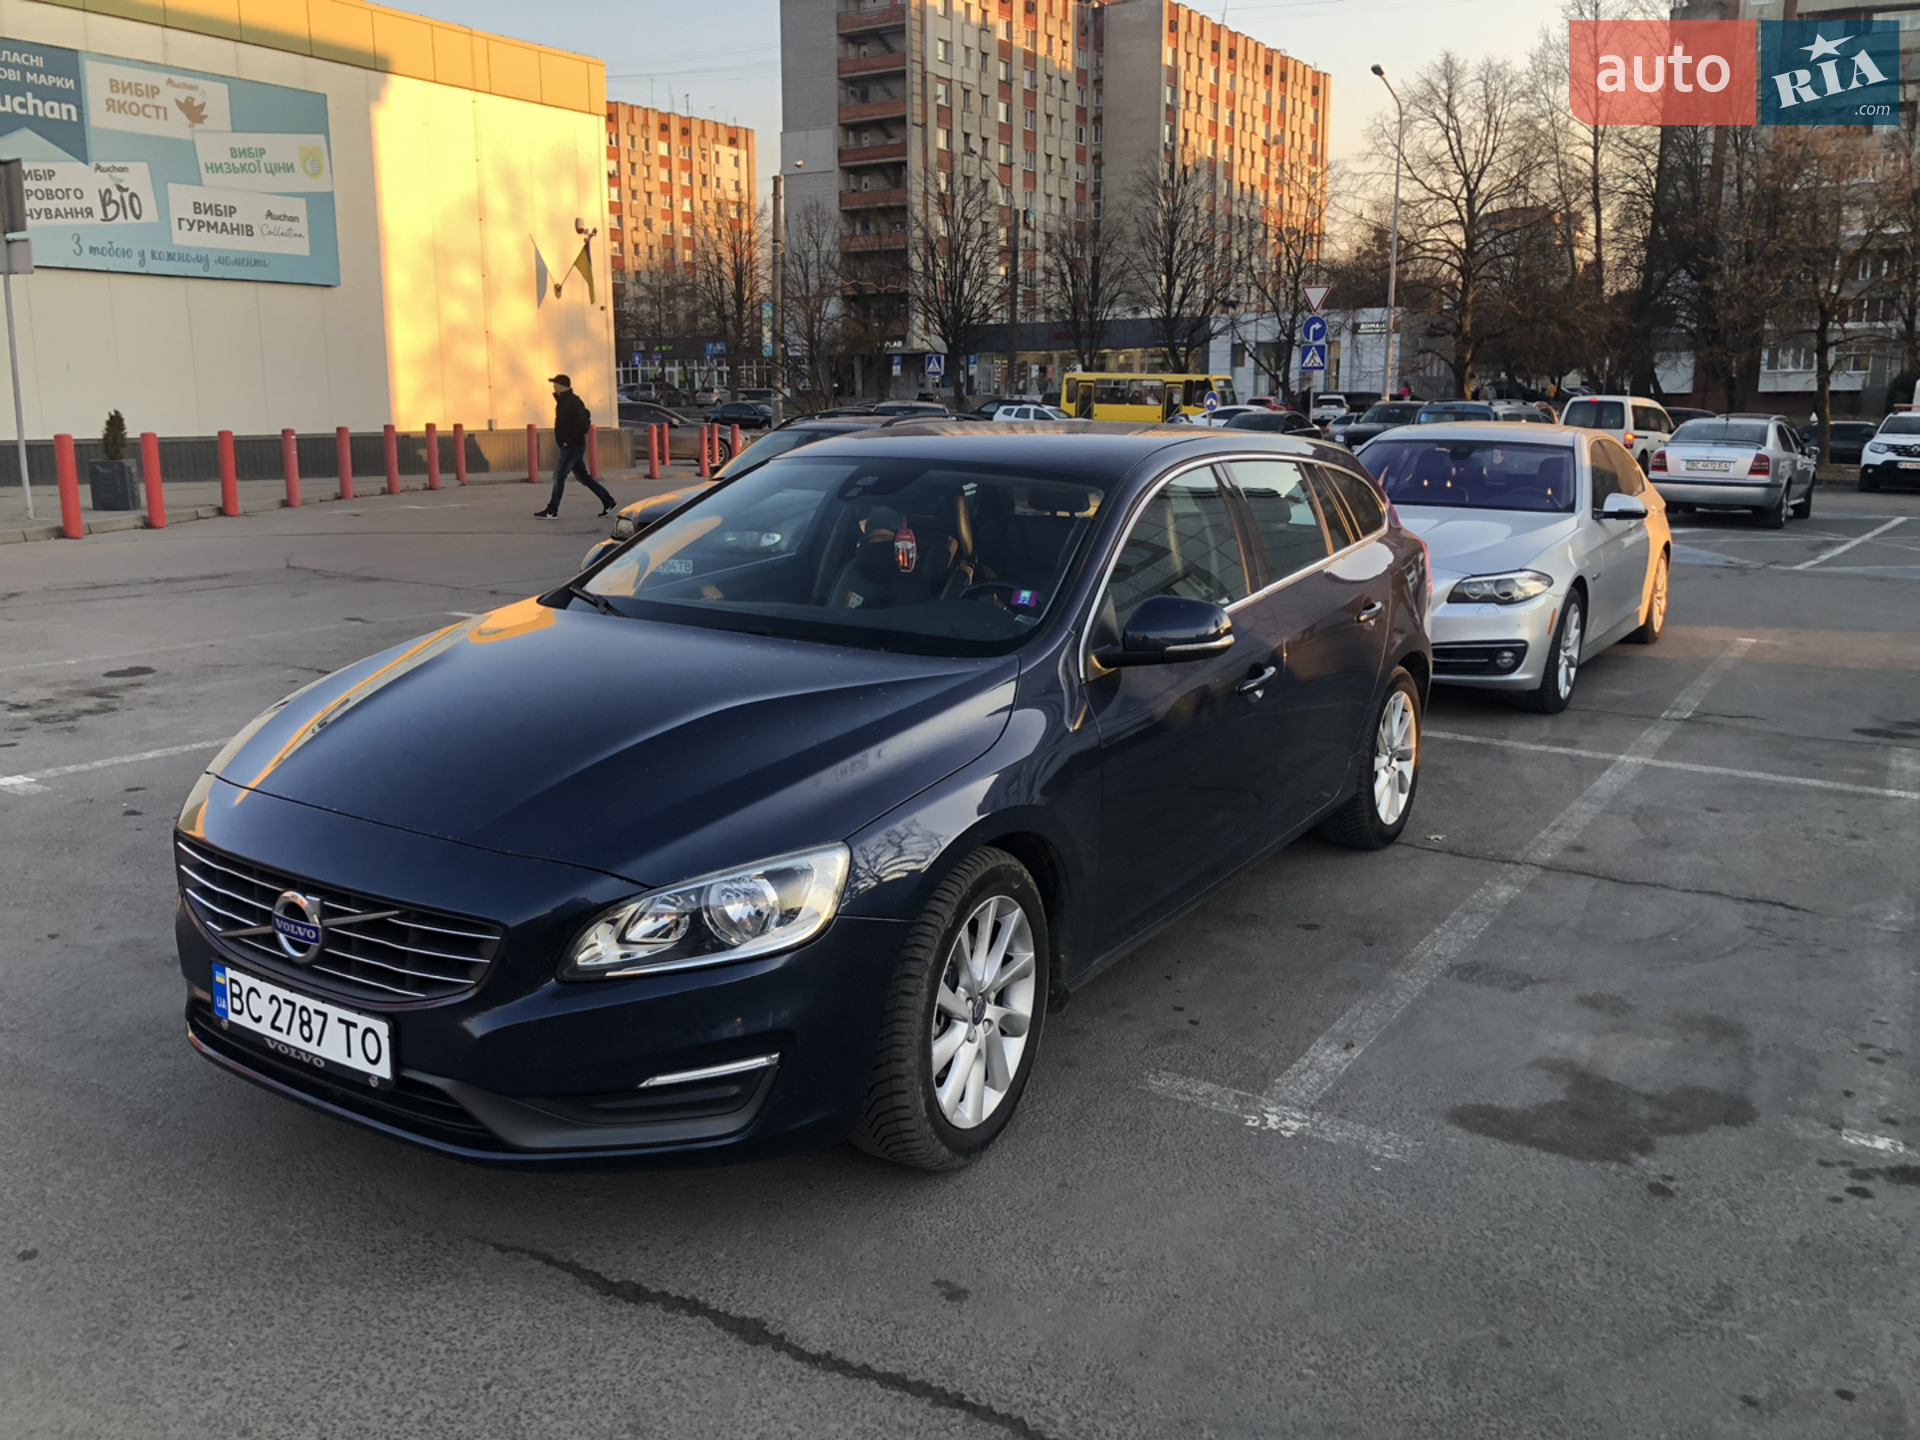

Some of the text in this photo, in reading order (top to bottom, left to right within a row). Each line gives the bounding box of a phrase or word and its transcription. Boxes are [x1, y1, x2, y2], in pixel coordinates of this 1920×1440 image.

[0, 50, 44, 68] ЛАСНІ
[0, 67, 75, 90] ОВІ МАРКИ
[166, 77, 199, 92] Auchan
[109, 78, 161, 100] ВИБІР
[0, 91, 78, 122] uchan
[105, 98, 169, 121] ЯКОСТІ
[229, 147, 267, 159] ВИБІР
[23, 169, 56, 181] ИБІР
[94, 163, 129, 173] Auchan
[205, 159, 296, 176] НИЗЬКОЇ ЦІНИ
[25, 188, 85, 201] РОВОГО
[26, 207, 94, 220] ЧУВАННЯ
[193, 201, 237, 218] ВИБІР
[265, 209, 300, 223] Auchan
[177, 217, 255, 237] ГУРМАНІВ
[89, 241, 133, 258] тобою
[138, 249, 146, 268] у
[151, 249, 210, 272] кожному
[214, 255, 270, 268] моменті
[275, 917, 317, 940] VOLVO
[216, 996, 227, 1010] UA
[228, 977, 382, 1066] BC 2787 TO
[263, 1036, 326, 1068] VOLVO
